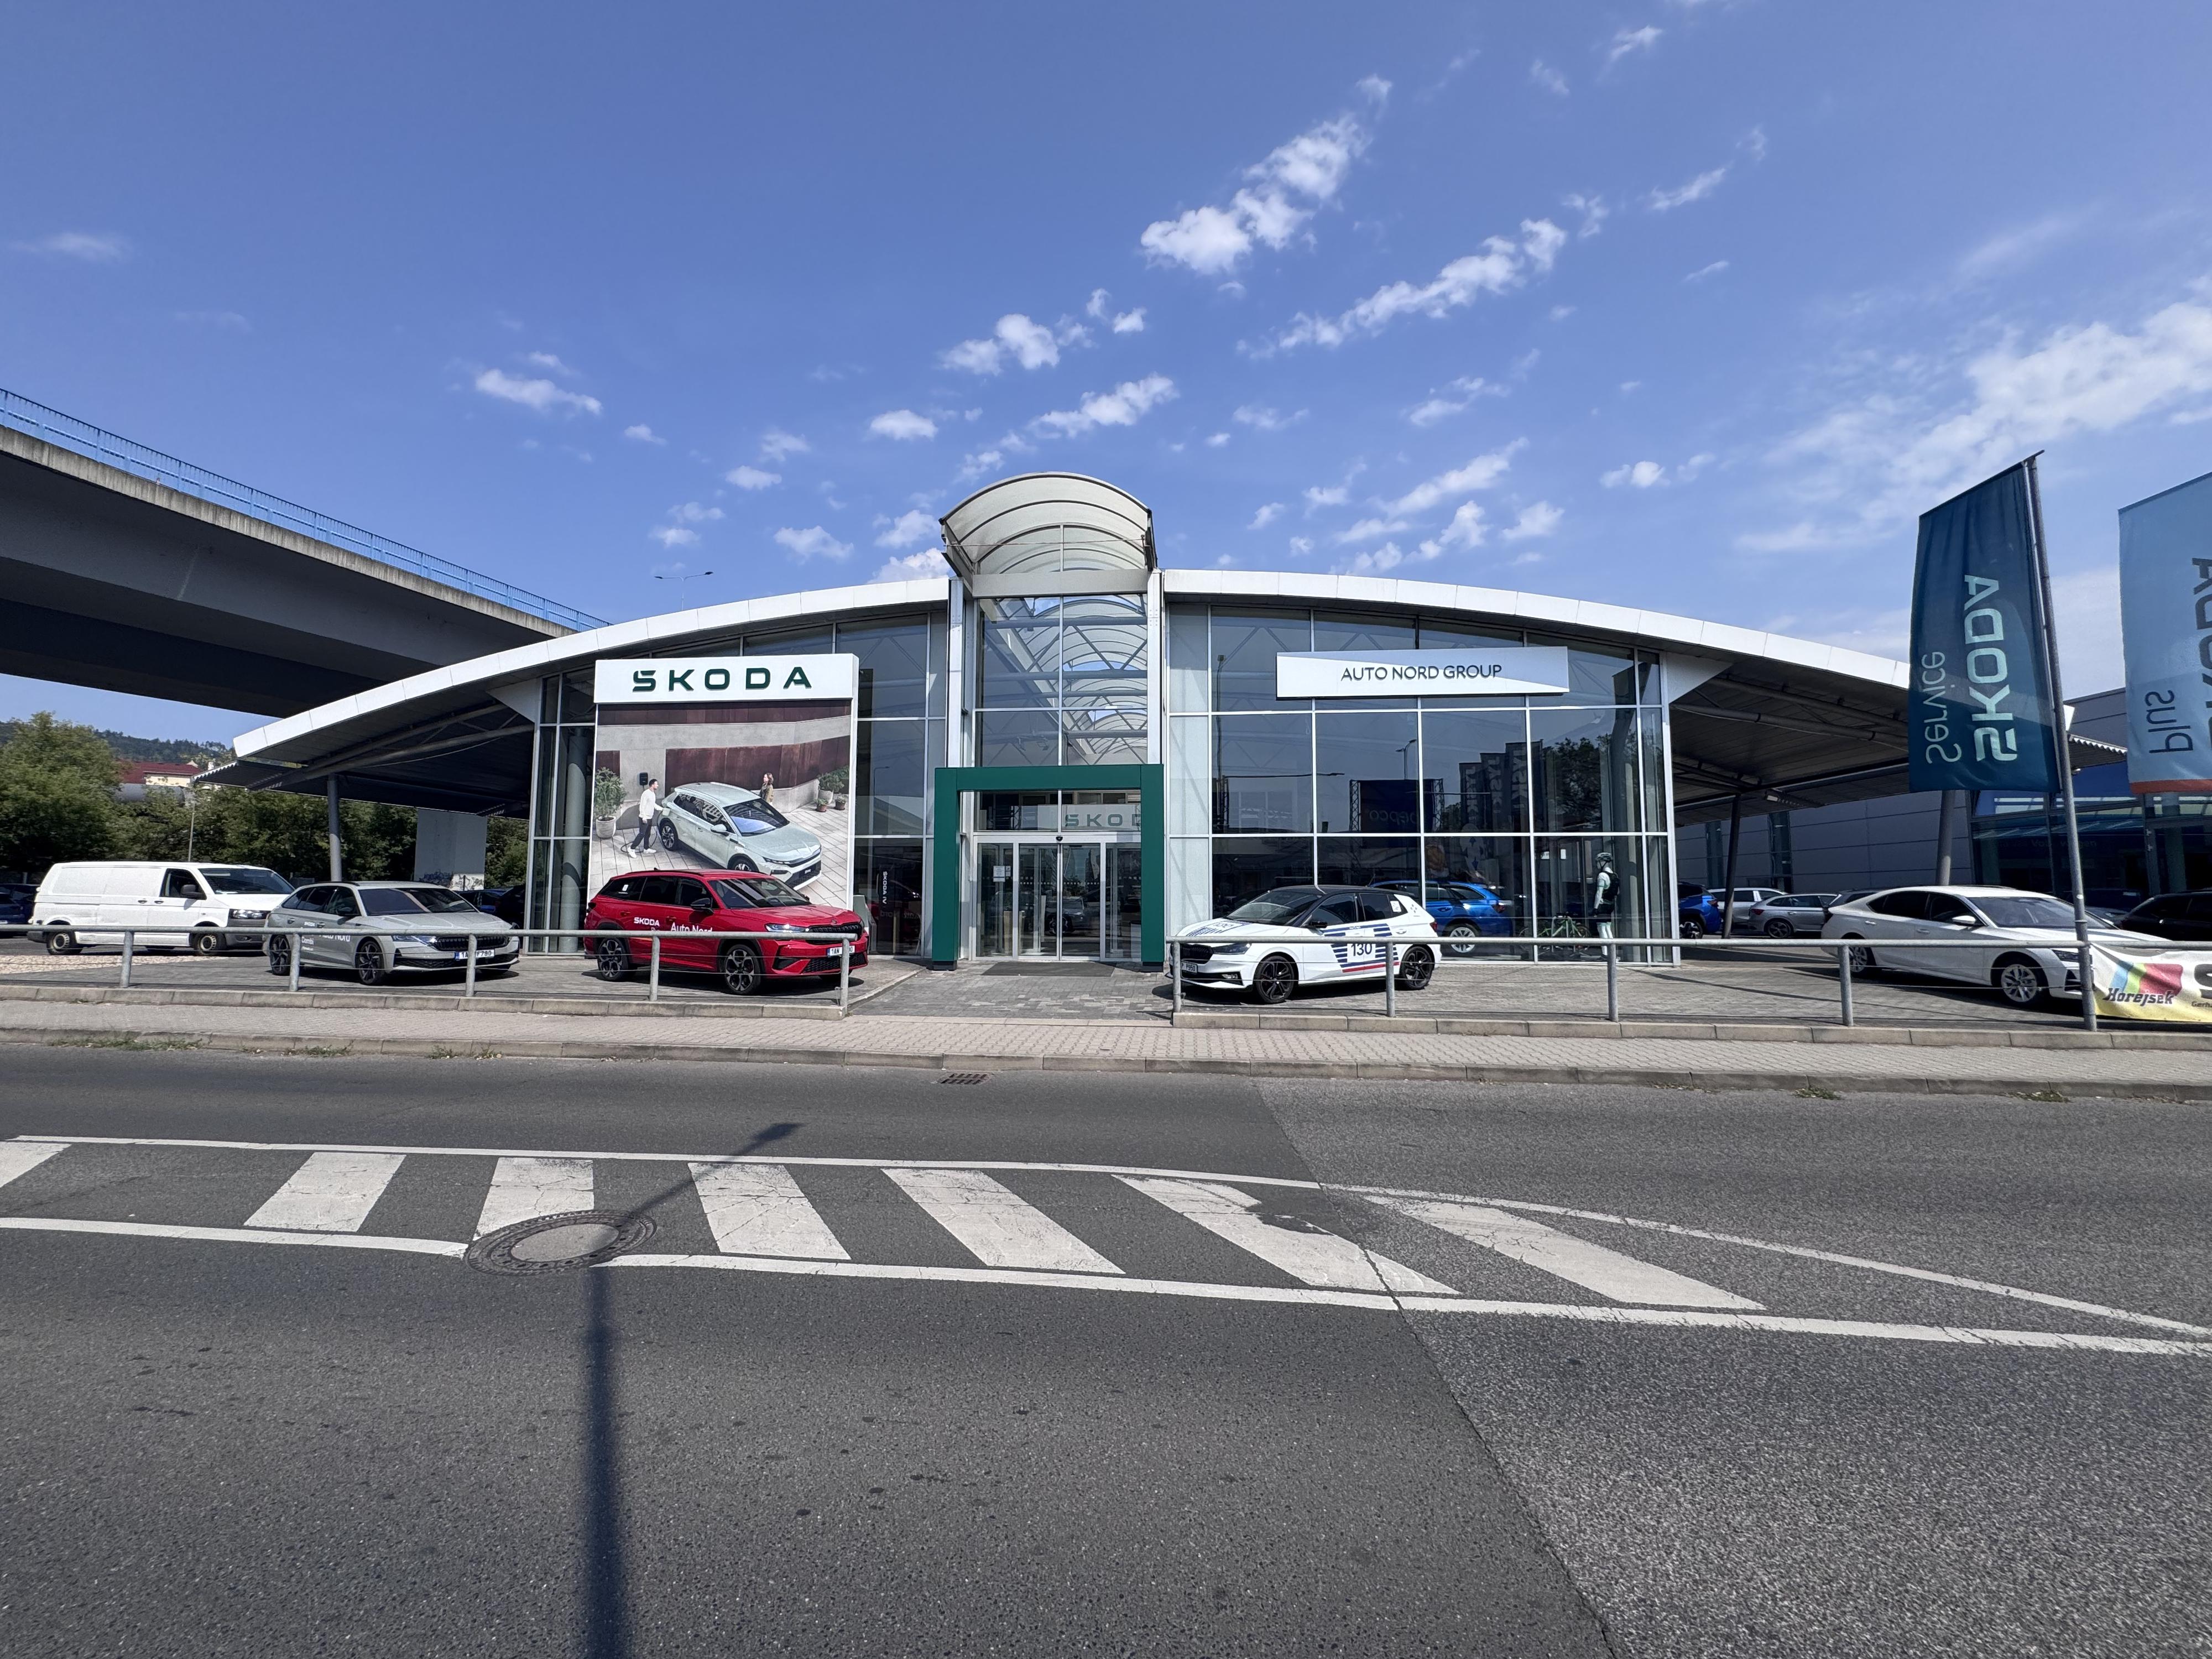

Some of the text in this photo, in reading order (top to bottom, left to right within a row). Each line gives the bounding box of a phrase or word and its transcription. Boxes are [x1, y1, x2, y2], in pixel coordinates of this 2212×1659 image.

[1340, 664, 1503, 681] AUTO NORD GROUP
[1350, 943, 1373, 956] 130
